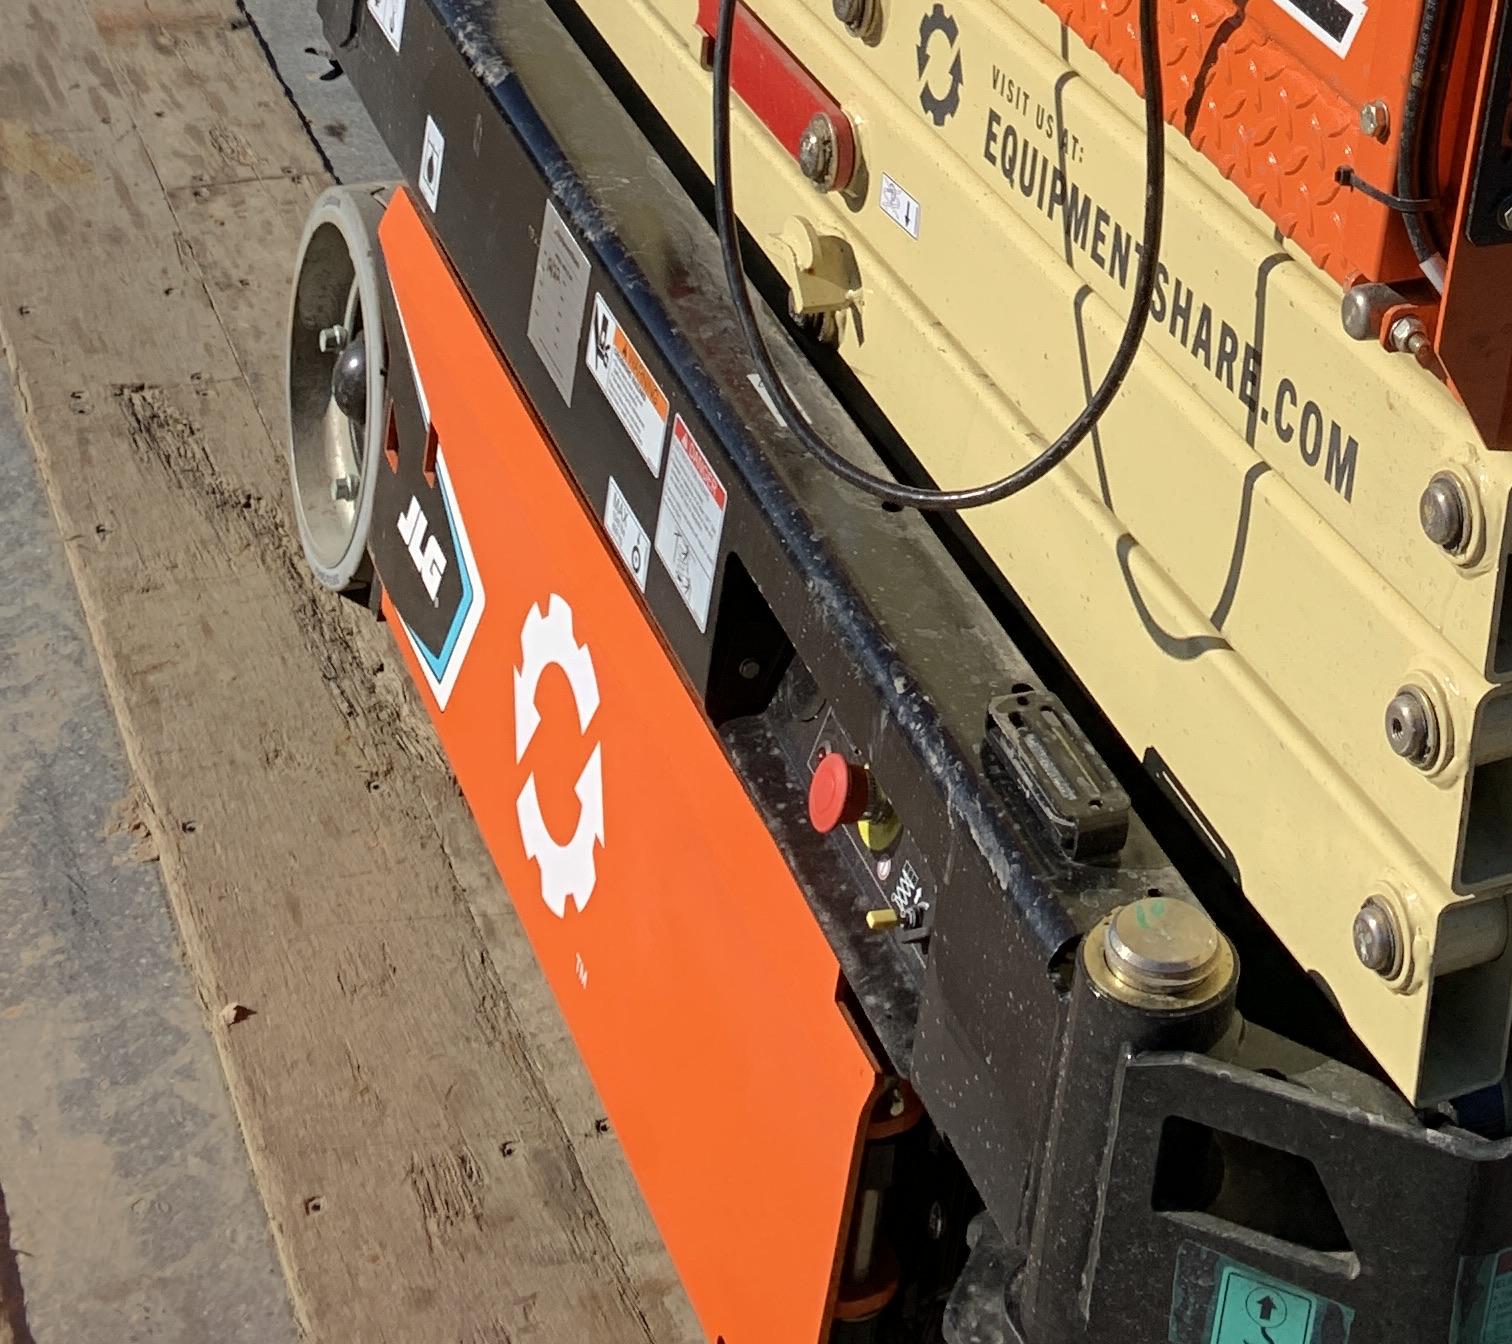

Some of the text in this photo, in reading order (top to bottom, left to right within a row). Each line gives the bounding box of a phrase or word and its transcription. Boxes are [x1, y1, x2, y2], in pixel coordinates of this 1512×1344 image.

[991, 64, 1031, 114] VISIT
[1034, 102, 1054, 139] US
[984, 109, 1360, 502] EQUIPMENSHARE.COM
[397, 495, 448, 603] JLG
